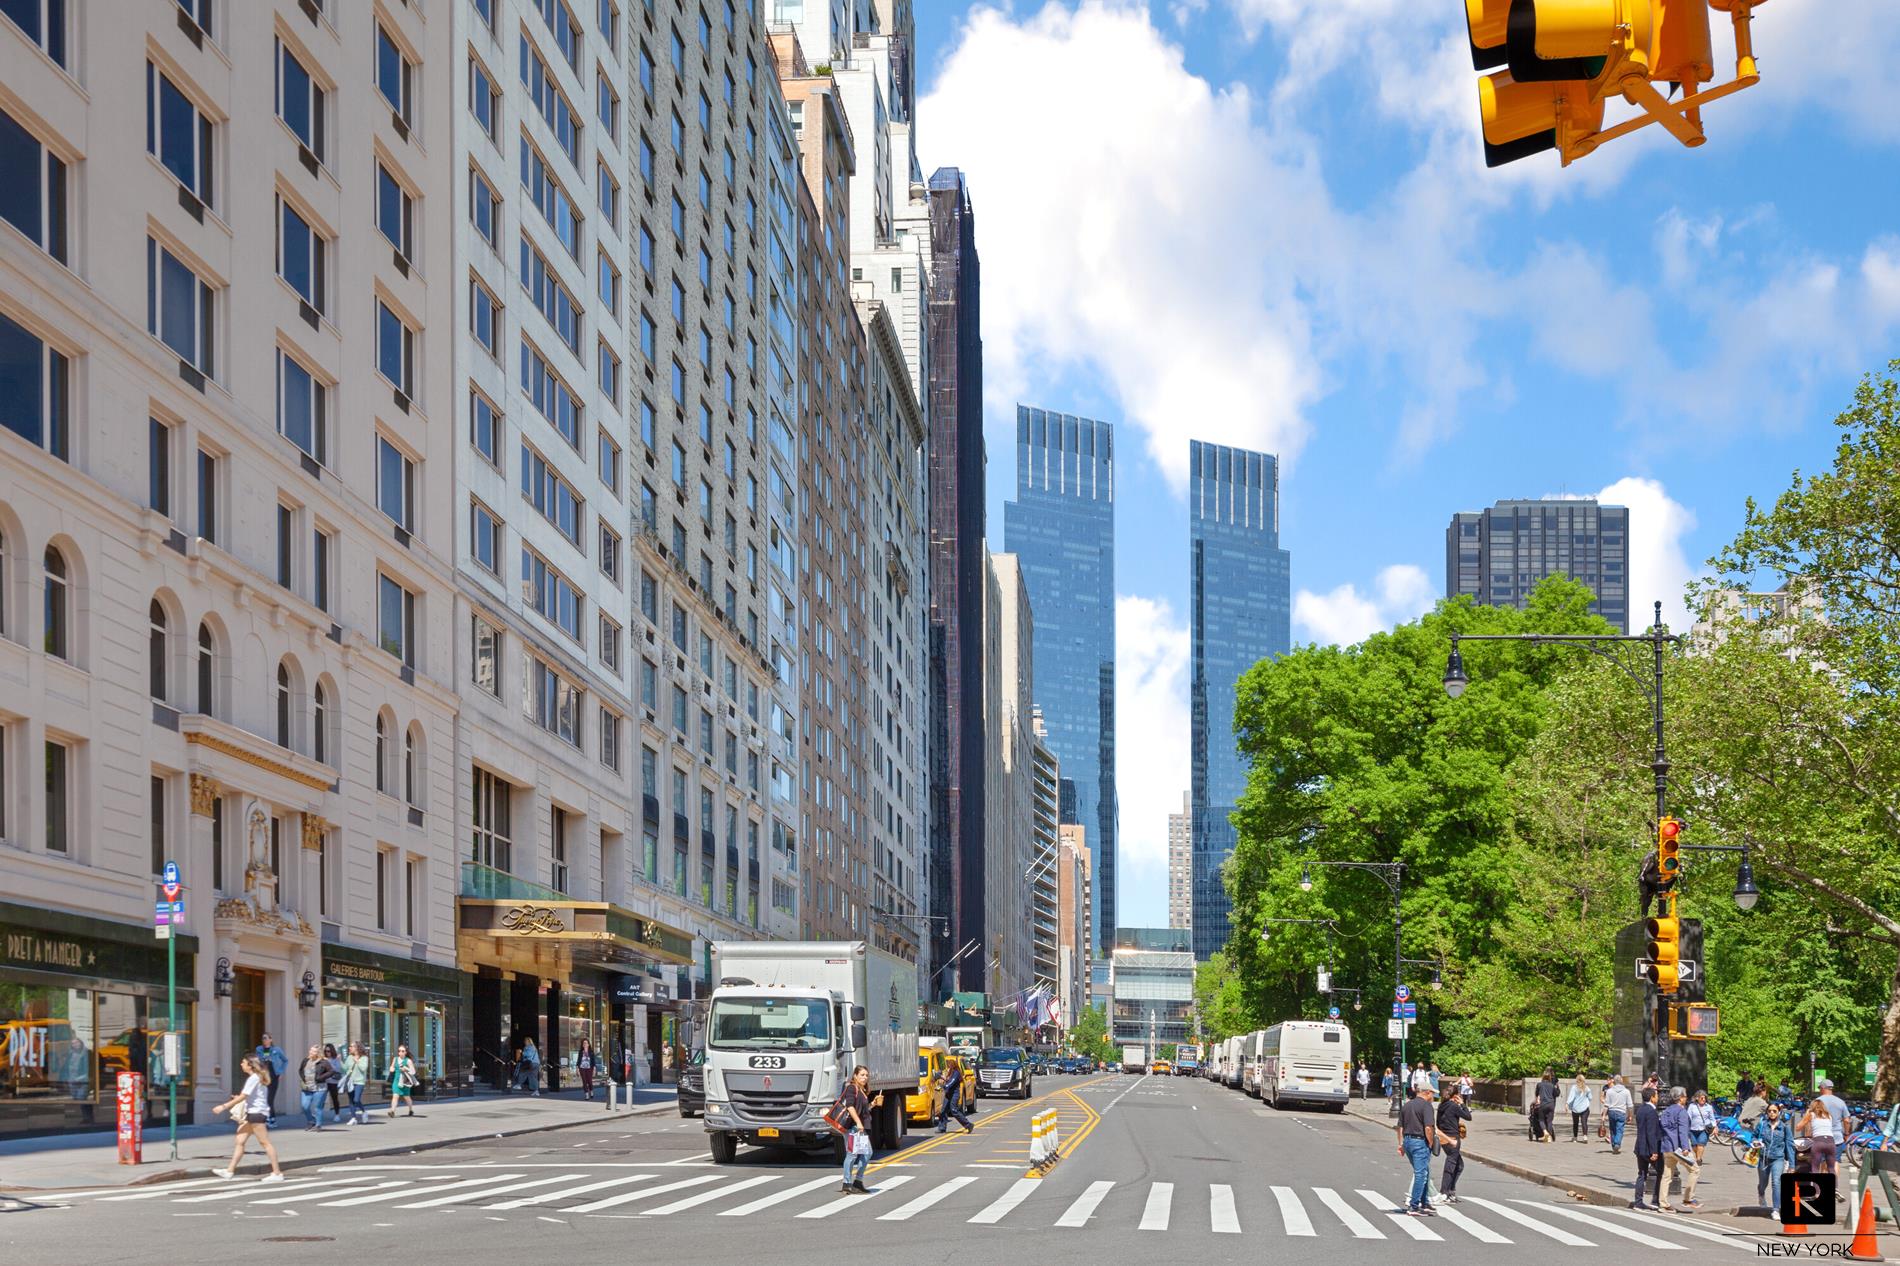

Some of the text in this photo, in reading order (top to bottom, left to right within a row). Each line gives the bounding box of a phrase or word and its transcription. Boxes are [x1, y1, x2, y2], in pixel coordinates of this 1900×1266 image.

[8, 934, 82, 967] PRET A MANGER
[330, 963, 384, 982] GALERIES BARTOUX
[10, 1026, 47, 1067] PRET
[754, 1057, 781, 1068] 233
